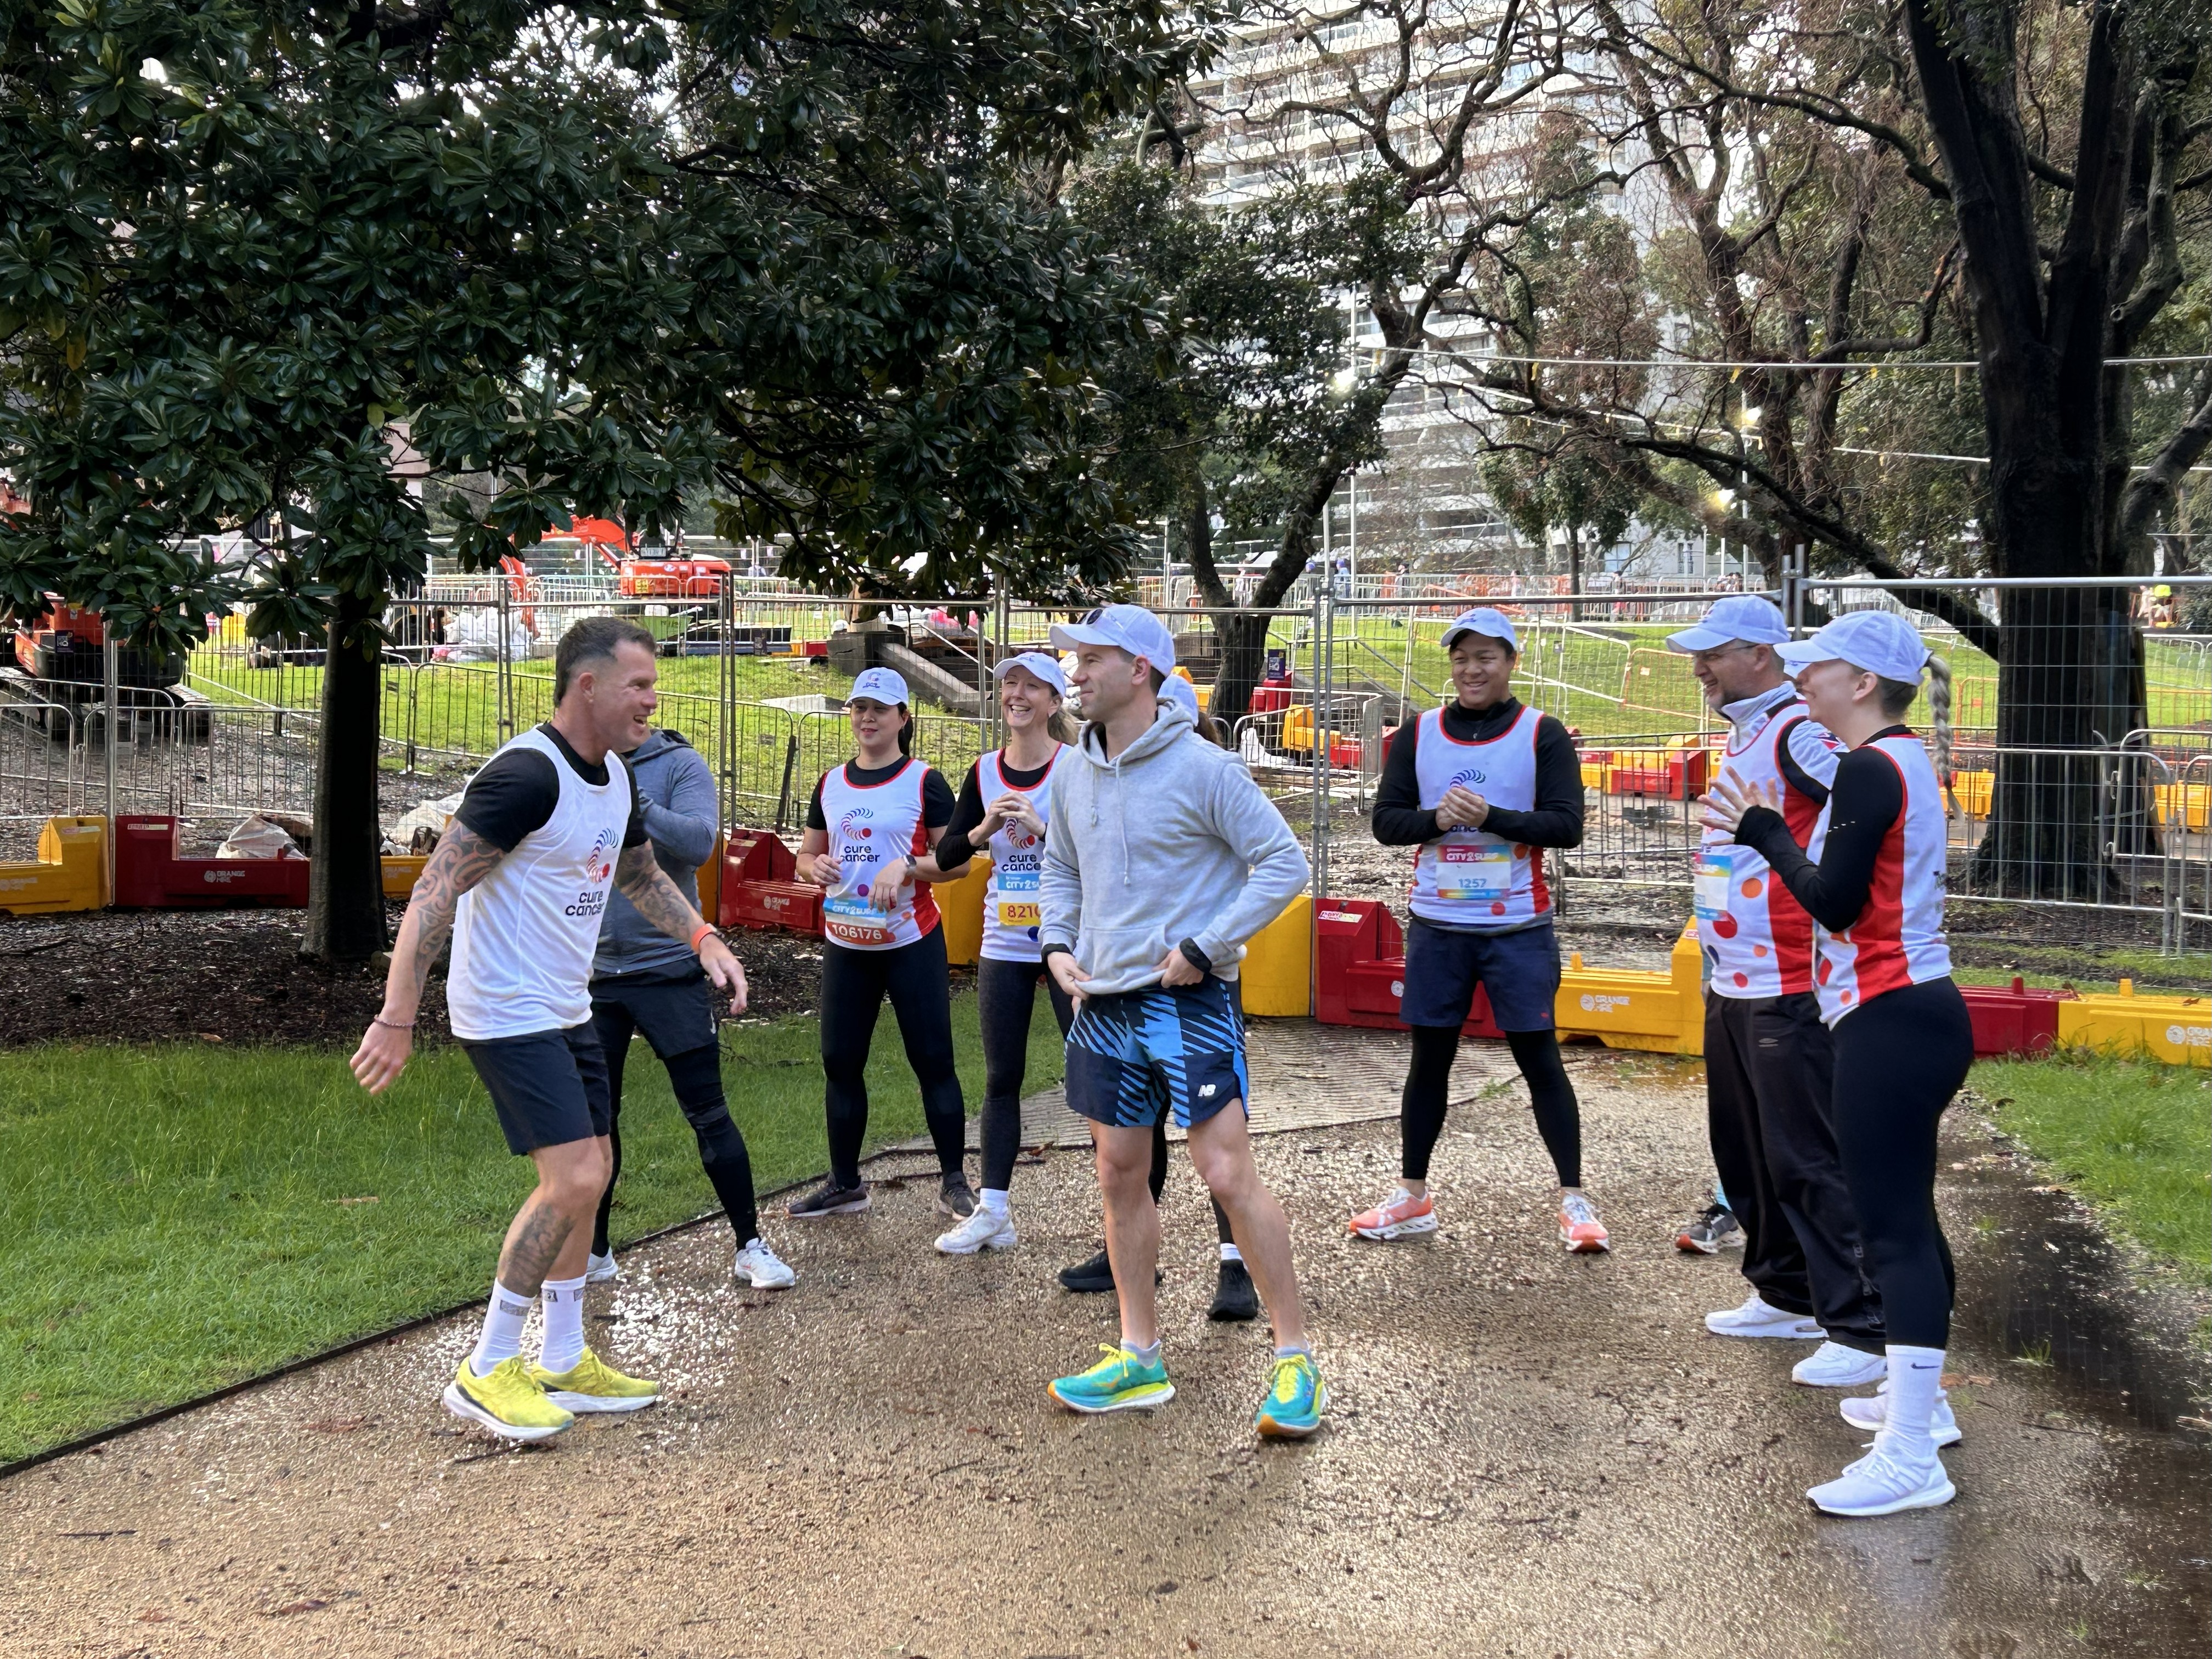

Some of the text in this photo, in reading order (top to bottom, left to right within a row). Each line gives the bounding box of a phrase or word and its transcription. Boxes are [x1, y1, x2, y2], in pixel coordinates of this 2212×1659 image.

[844, 845, 872, 854] cure
[1009, 854, 1037, 863] cure
[1002, 862, 1041, 872] cance
[1458, 878, 1487, 888] 1257
[579, 890, 603, 904] cure
